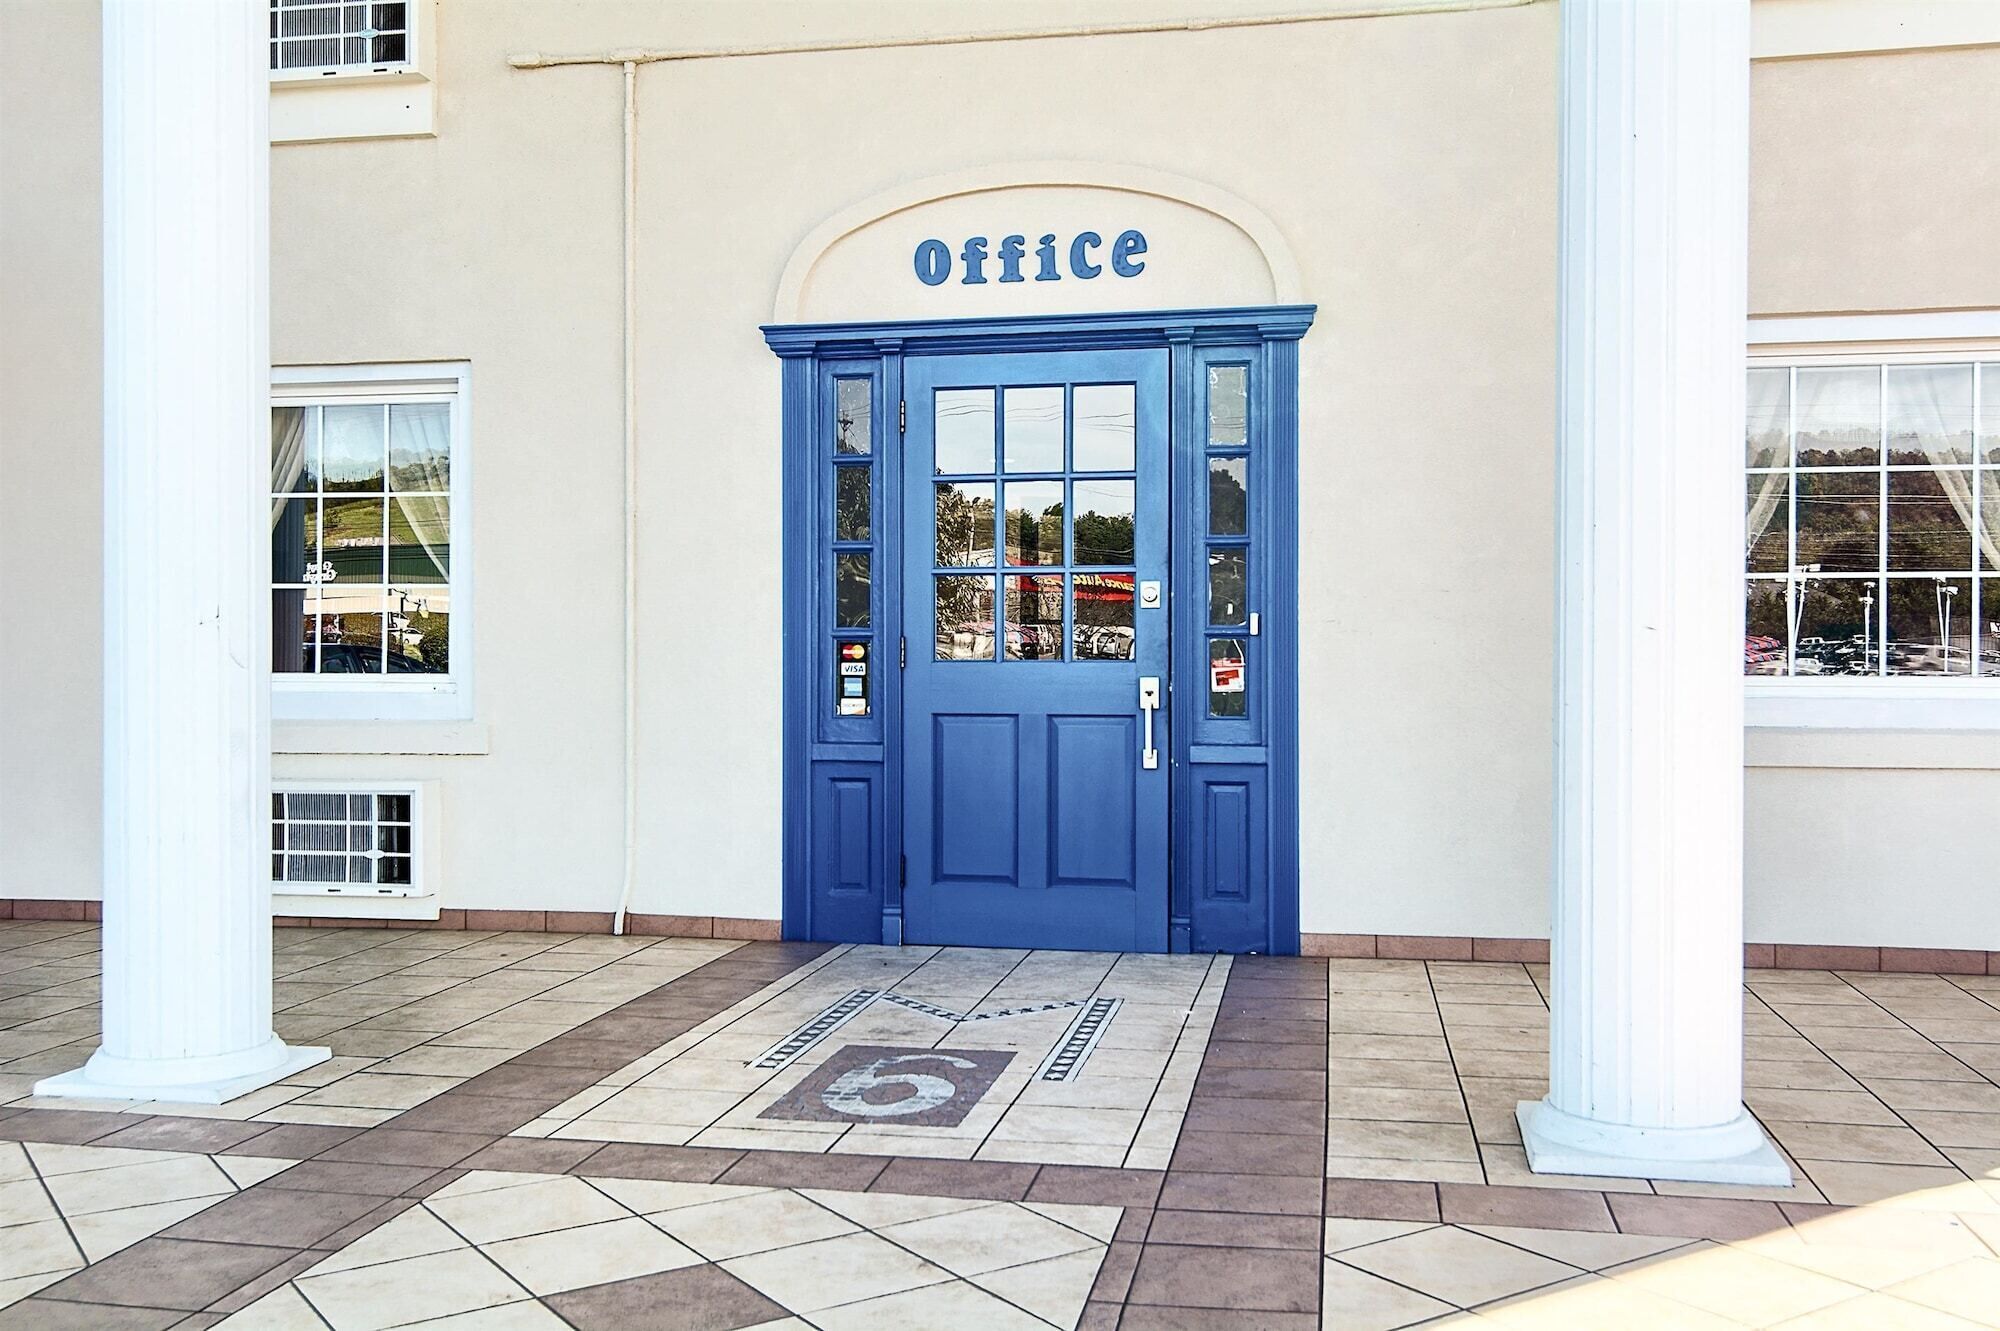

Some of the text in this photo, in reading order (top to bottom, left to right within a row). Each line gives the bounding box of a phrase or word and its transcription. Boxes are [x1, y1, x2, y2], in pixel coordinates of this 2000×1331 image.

[914, 229, 1148, 286] Office
[844, 665, 864, 673] VISA
[821, 1054, 978, 1117] 6
